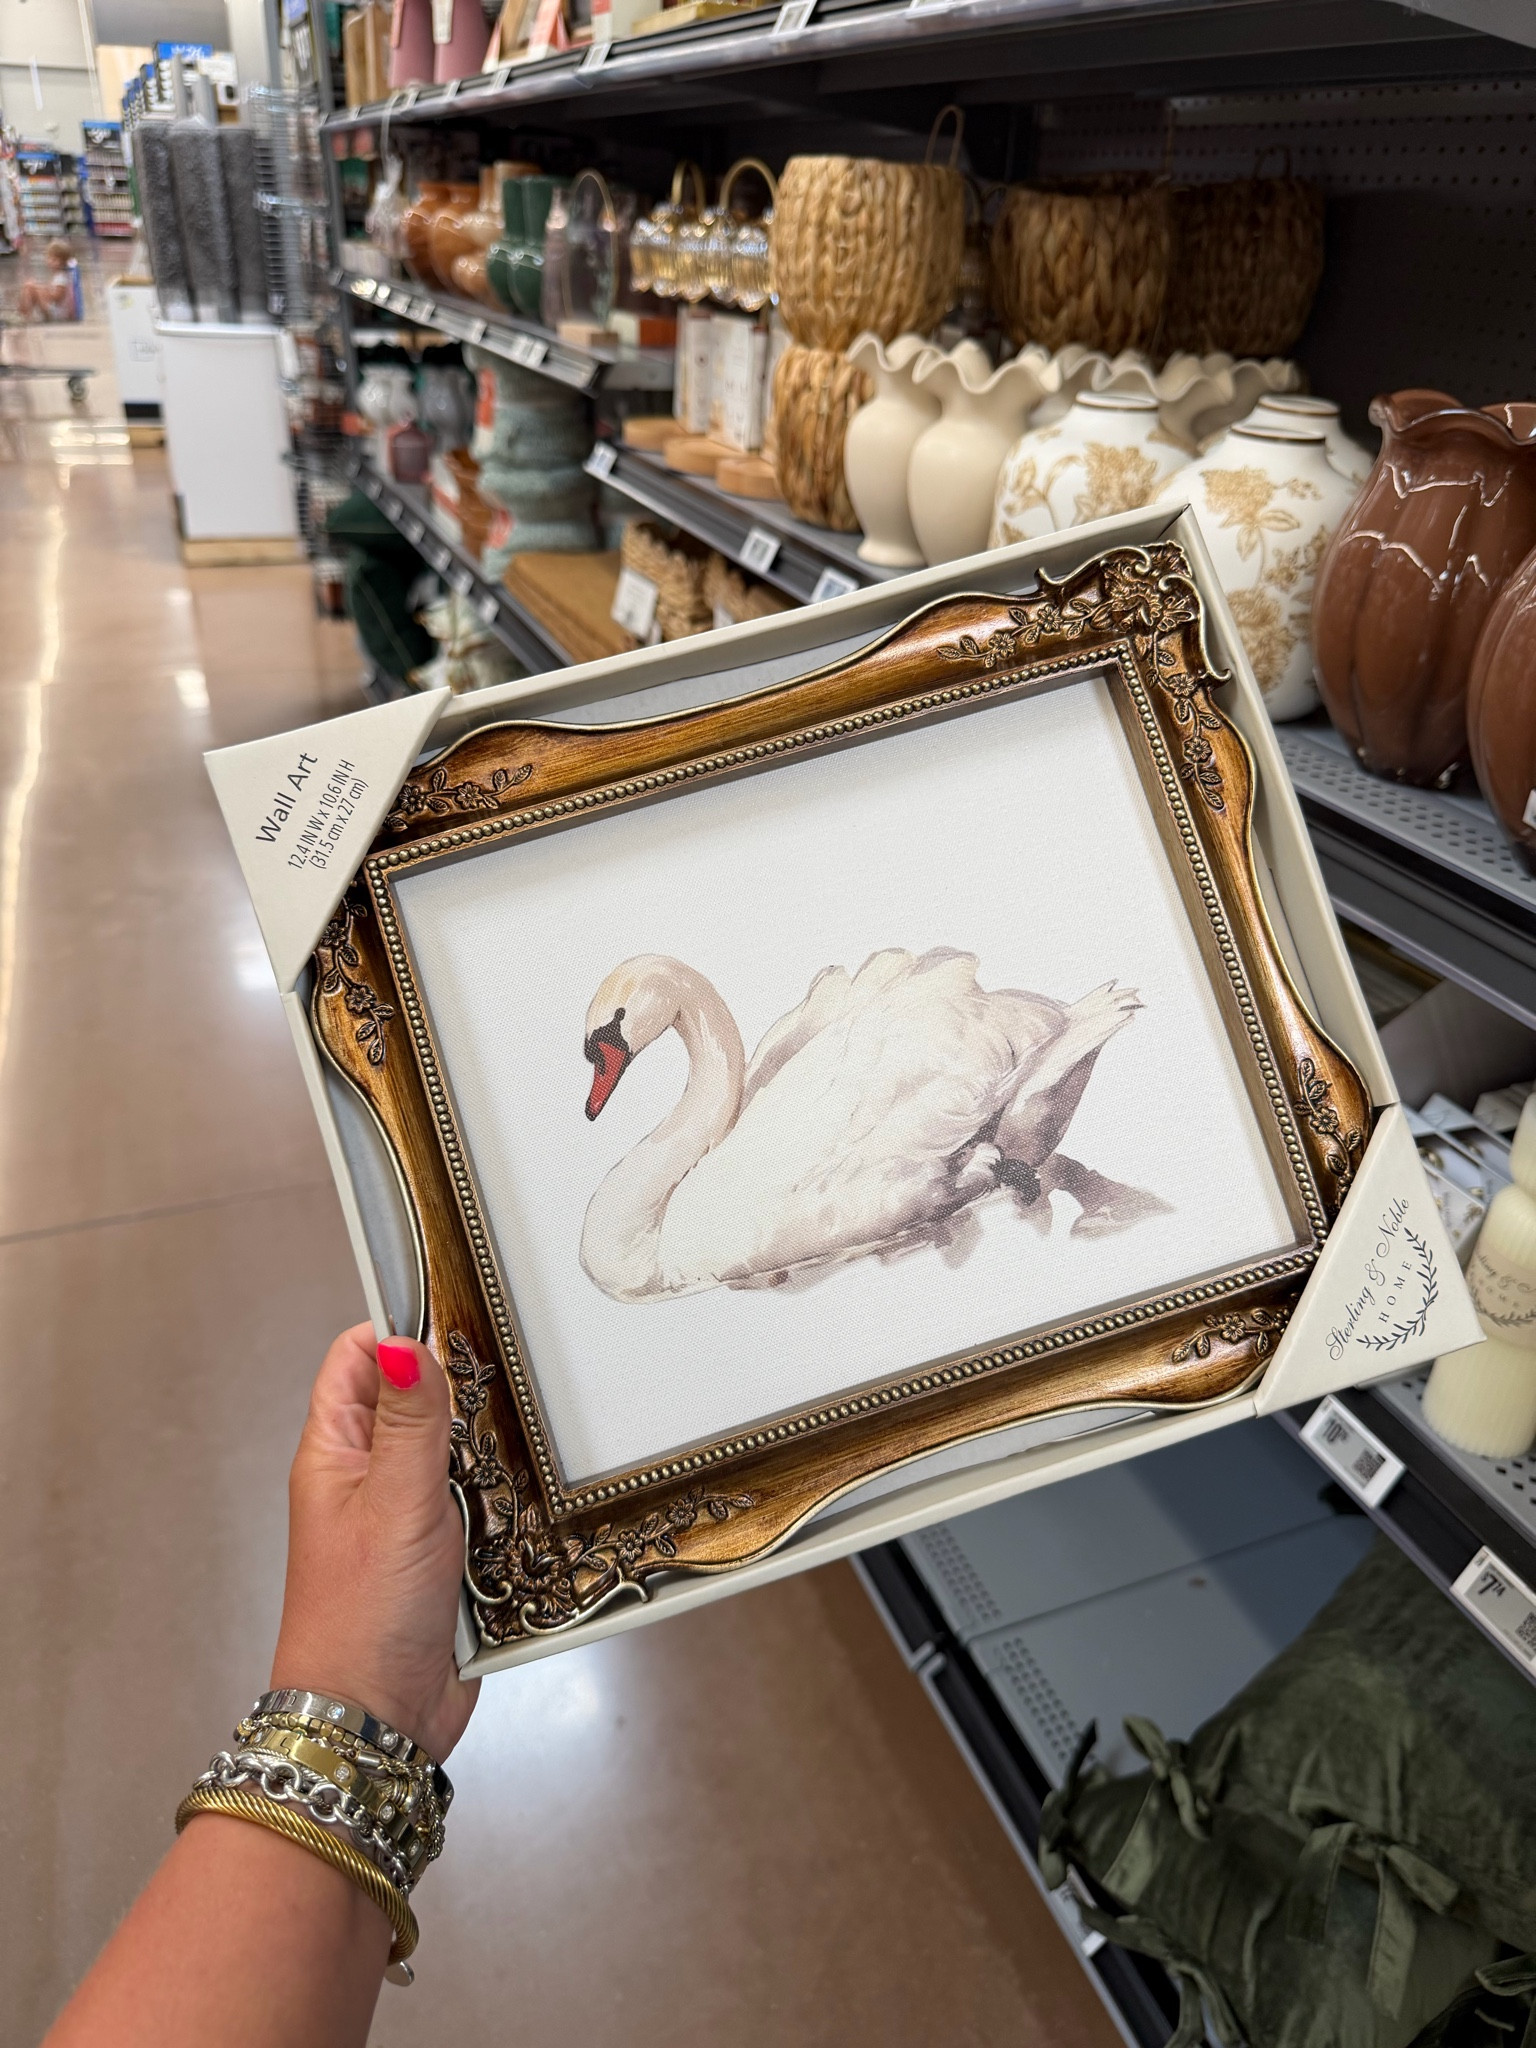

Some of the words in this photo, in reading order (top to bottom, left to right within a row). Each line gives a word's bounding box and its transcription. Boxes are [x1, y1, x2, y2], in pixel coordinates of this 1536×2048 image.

[330, 769, 350, 786] IN
[338, 758, 356, 772] H
[255, 791, 297, 843] Wall
[287, 752, 319, 792] Art
[319, 783, 342, 809] 10.6
[306, 815, 325, 831] W
[308, 839, 335, 869] (31.5
[327, 823, 345, 841] cm
[337, 798, 356, 816] 27
[349, 777, 369, 800] cm)
[299, 829, 319, 847] IN
[287, 844, 312, 869] 12.4
[1325, 1286, 1376, 1361] Sterling
[1364, 1258, 1386, 1287] &
[1376, 1197, 1410, 1258] Noble
[1377, 1260, 1412, 1323] HOME
